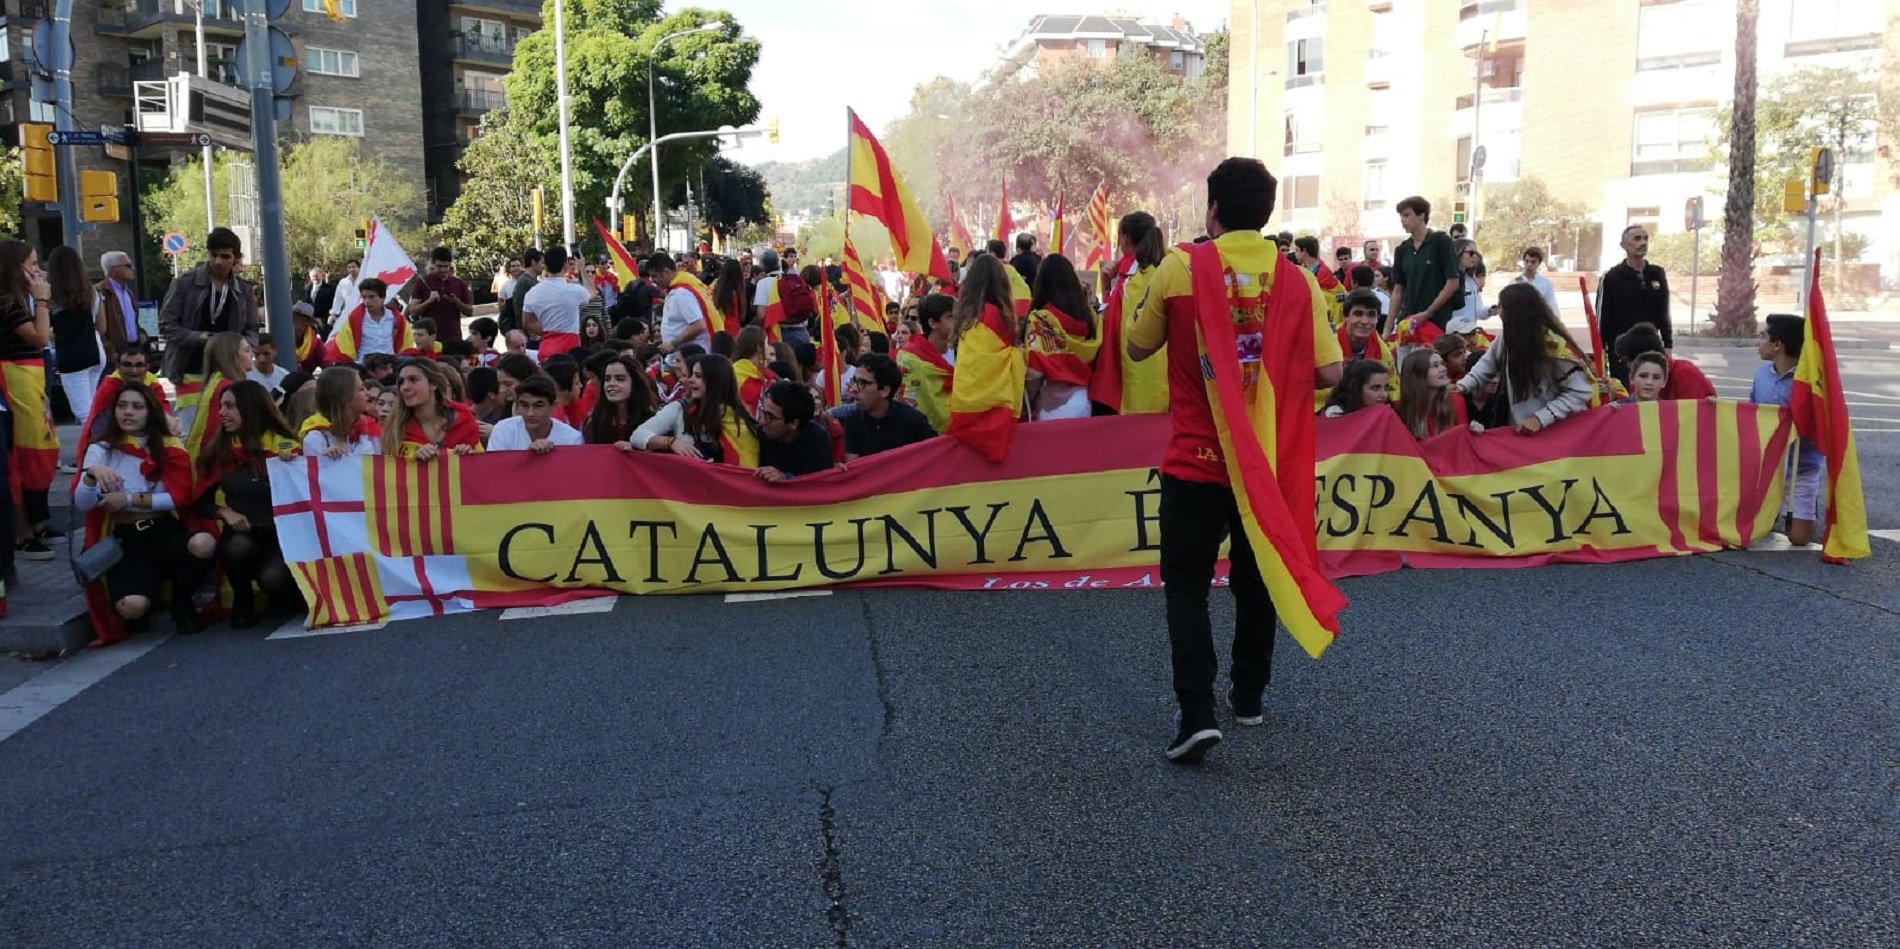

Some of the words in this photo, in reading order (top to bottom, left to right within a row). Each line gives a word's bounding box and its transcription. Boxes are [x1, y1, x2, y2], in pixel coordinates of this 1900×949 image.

[498, 498, 1073, 583] CATALUNYA
[982, 577, 1049, 589] Los
[1064, 576, 1110, 588] de
